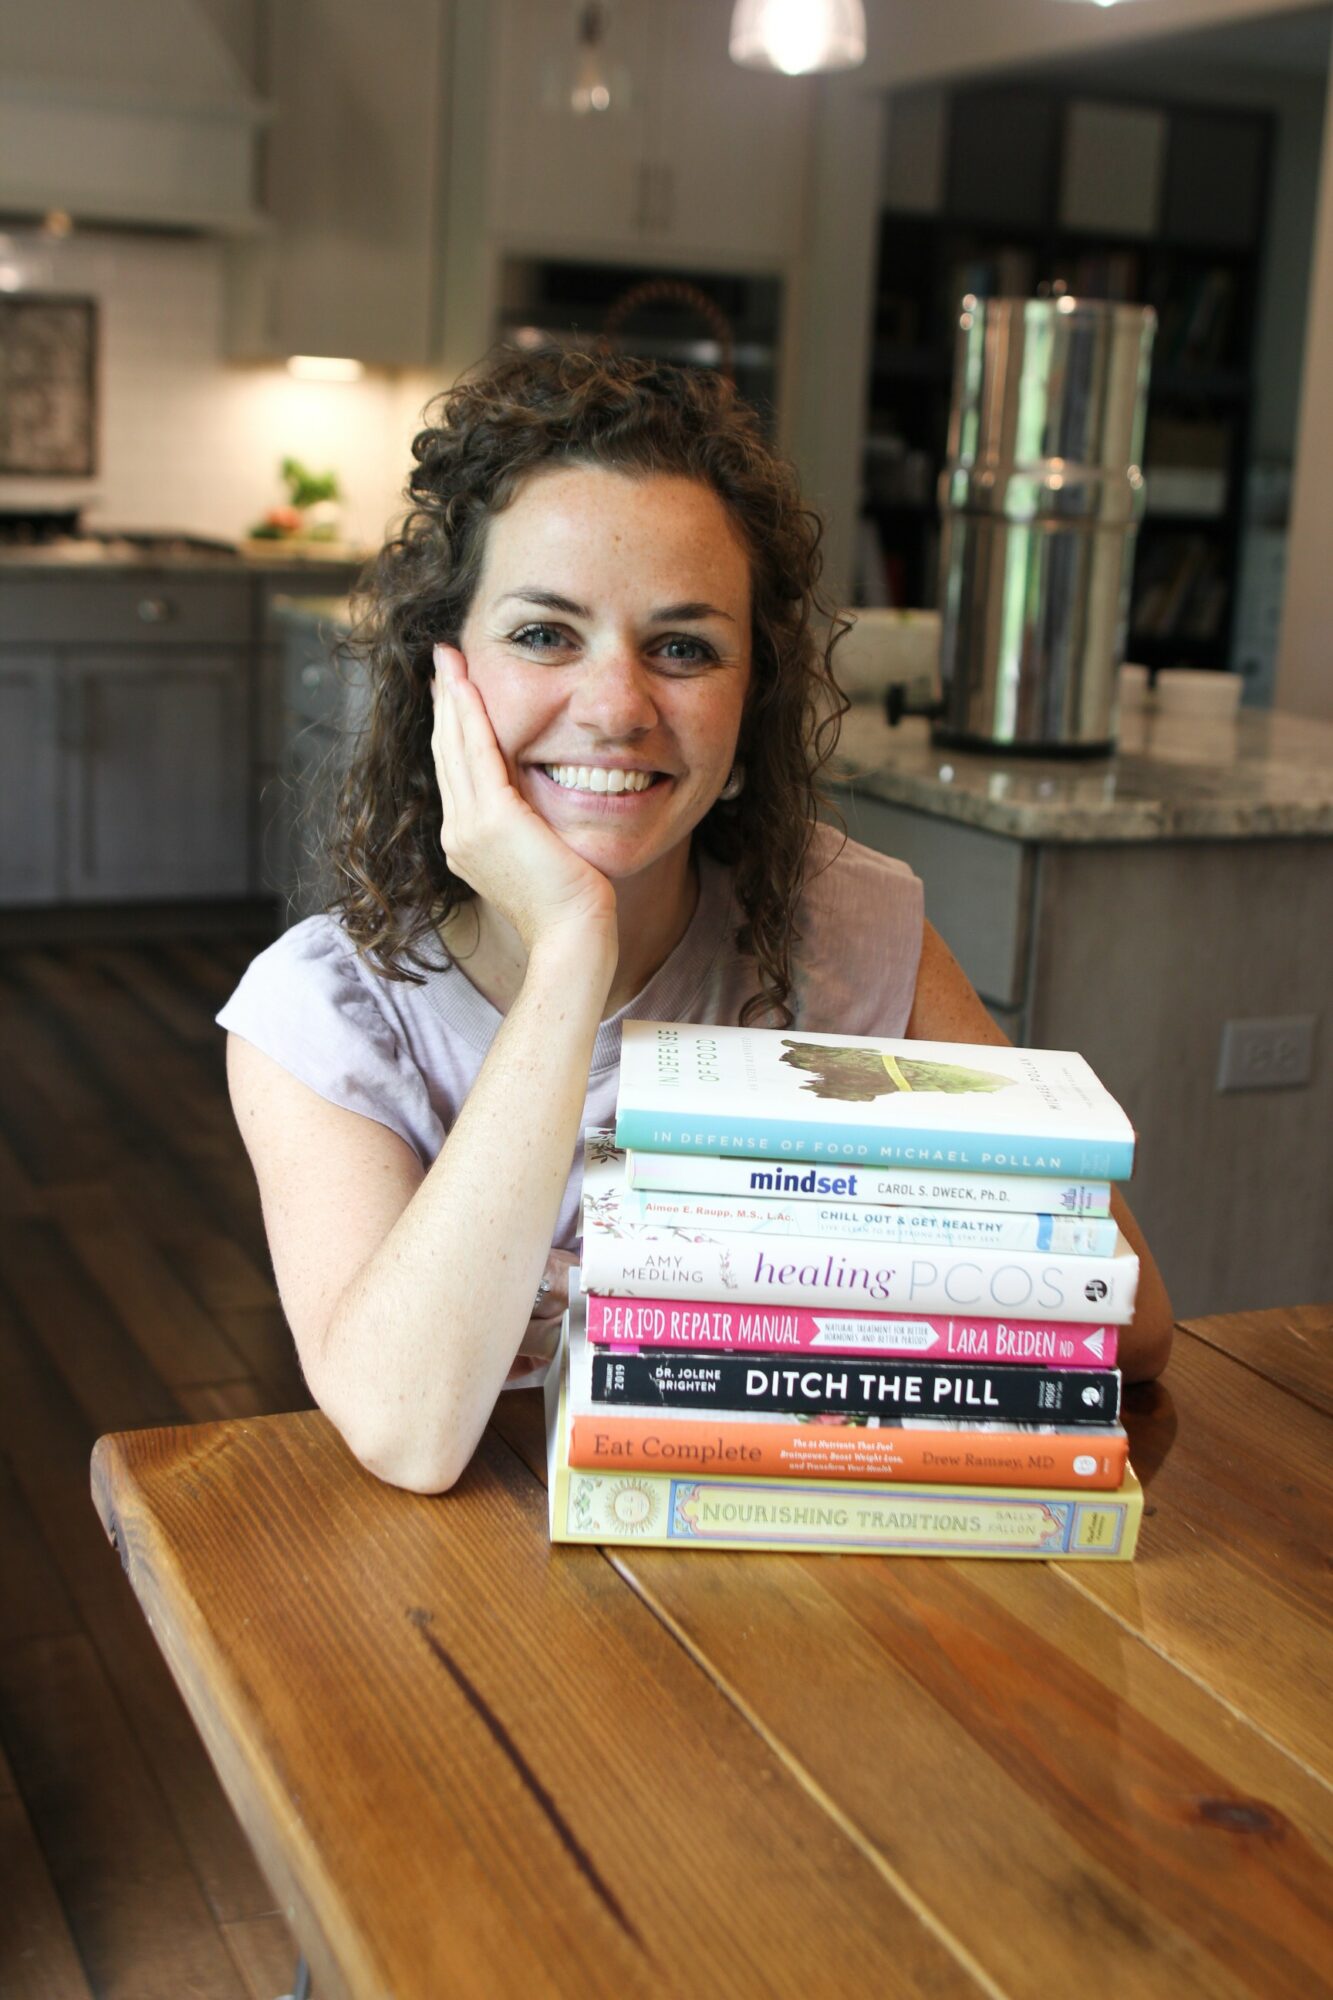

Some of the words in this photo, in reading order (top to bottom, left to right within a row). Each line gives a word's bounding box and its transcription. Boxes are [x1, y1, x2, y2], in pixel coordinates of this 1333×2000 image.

[658, 1030, 680, 1073] DEFENSE
[696, 1039, 718, 1067] FOOD
[698, 1069, 720, 1082] OF
[654, 1131, 672, 1143] IN
[681, 1133, 768, 1149] DEFENSE
[781, 1139, 805, 1151] OF
[815, 1142, 868, 1155] FOOD
[880, 1146, 969, 1163] MICHAEL
[981, 1152, 1062, 1168] POLLAN
[750, 1167, 857, 1196] mindset
[877, 1182, 915, 1196] CAROL
[919, 1185, 929, 1197] S.
[932, 1186, 977, 1201] DWECK,
[981, 1189, 1011, 1202] Ph.D.
[645, 1203, 680, 1213] Aimee
[683, 1206, 693, 1214] E.
[820, 1210, 859, 1222] CHILL
[864, 1213, 892, 1225] OUT
[896, 1216, 906, 1225] &
[911, 1217, 937, 1227] GET
[942, 1219, 1004, 1233] HEALTHY
[622, 1267, 703, 1283] MEDLING
[645, 1255, 683, 1268] AMY
[754, 1252, 896, 1300] healing
[909, 1260, 1064, 1309] PCOS
[602, 1306, 666, 1340] PERIOD
[670, 1311, 732, 1342] REPAIR
[738, 1314, 801, 1345] MANUAL
[947, 1321, 988, 1355] LARA
[995, 1323, 1056, 1358] BRIDEN
[1059, 1343, 1075, 1358] ND
[614, 1363, 625, 1391] 2019
[655, 1368, 675, 1379] DR.
[678, 1368, 721, 1380] JOLENE
[658, 1380, 716, 1392] BRIGHTEN
[746, 1369, 848, 1399] DITCH
[859, 1374, 922, 1402] THE
[933, 1377, 999, 1405] PILL
[594, 1434, 635, 1456] Eat
[642, 1436, 762, 1463] Complete
[922, 1451, 960, 1465] Drew
[965, 1453, 1023, 1469] Ramsey,
[1028, 1456, 1056, 1469] MD
[702, 1502, 848, 1527] NOURISHING
[856, 1510, 981, 1533] TRADITIONS
